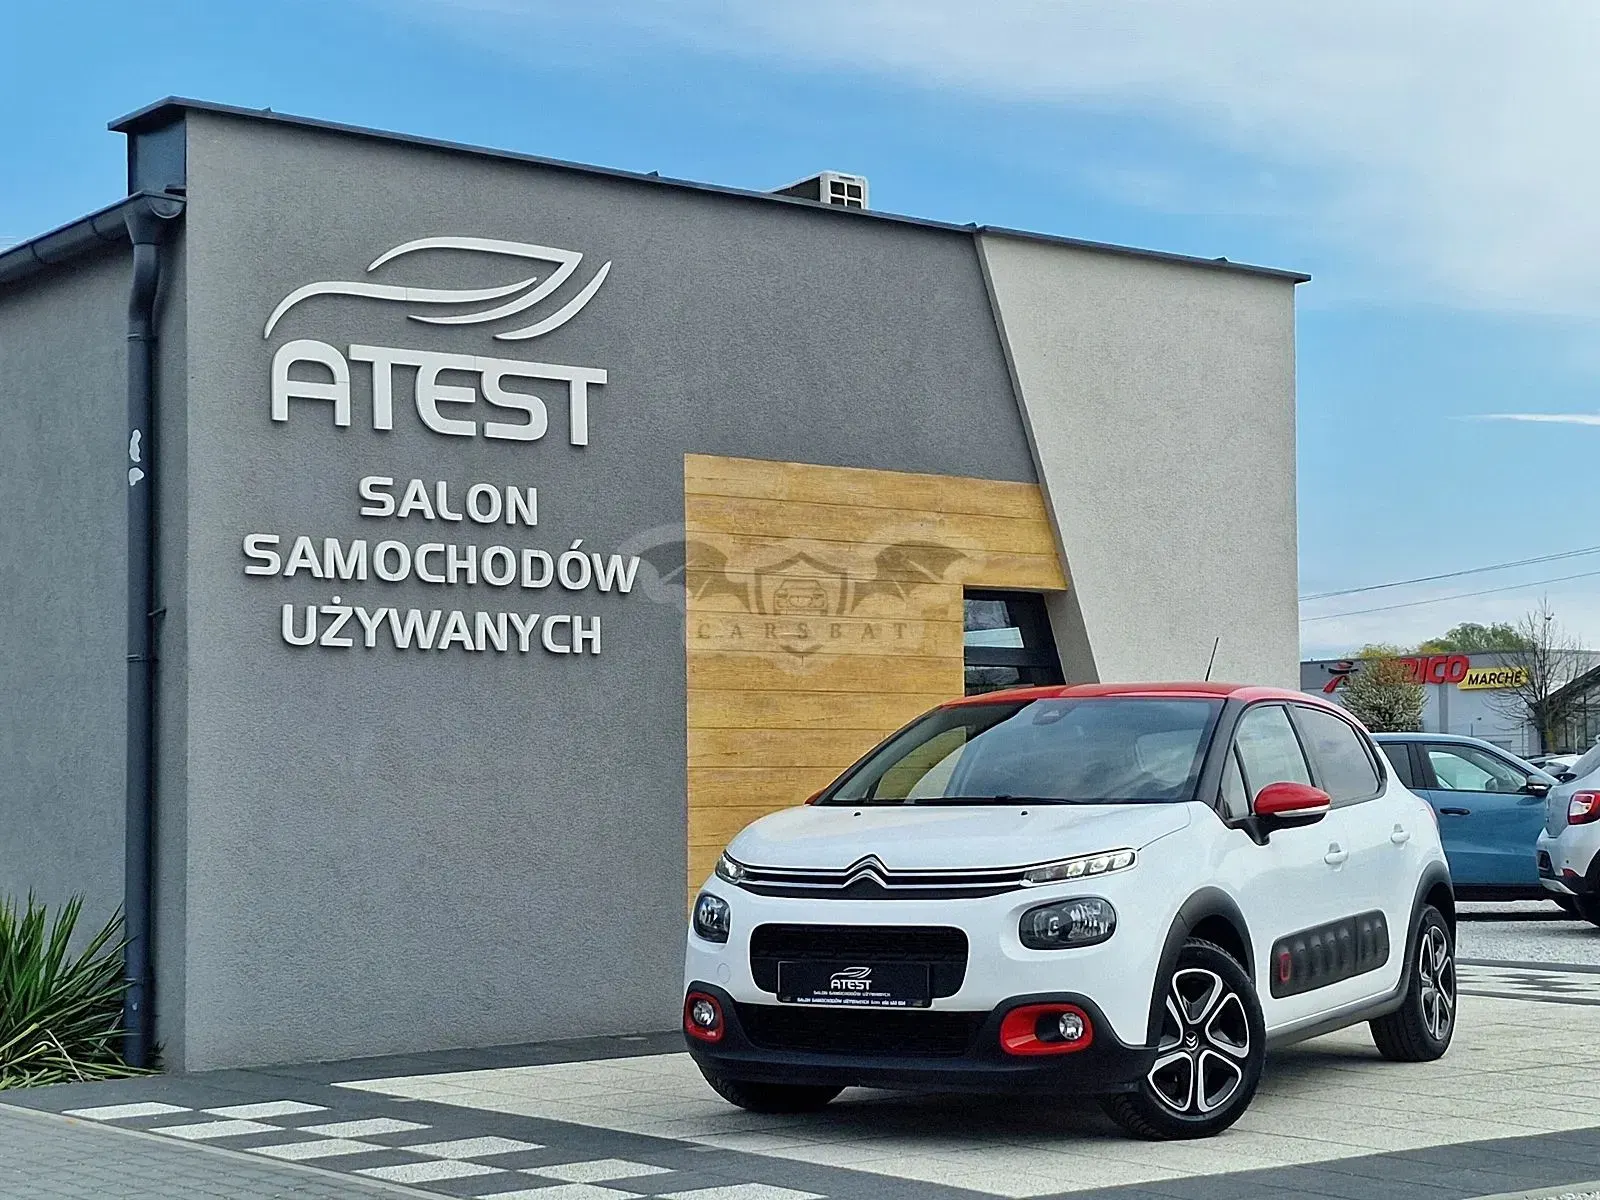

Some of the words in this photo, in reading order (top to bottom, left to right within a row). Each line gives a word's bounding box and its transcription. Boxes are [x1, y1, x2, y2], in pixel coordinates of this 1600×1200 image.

[271, 339, 608, 446] ATEST
[359, 476, 538, 526] SALON
[243, 533, 641, 593] SAMOCHODÓW
[281, 596, 602, 654] UŻYWANYCH
[830, 979, 872, 990] ATEST
